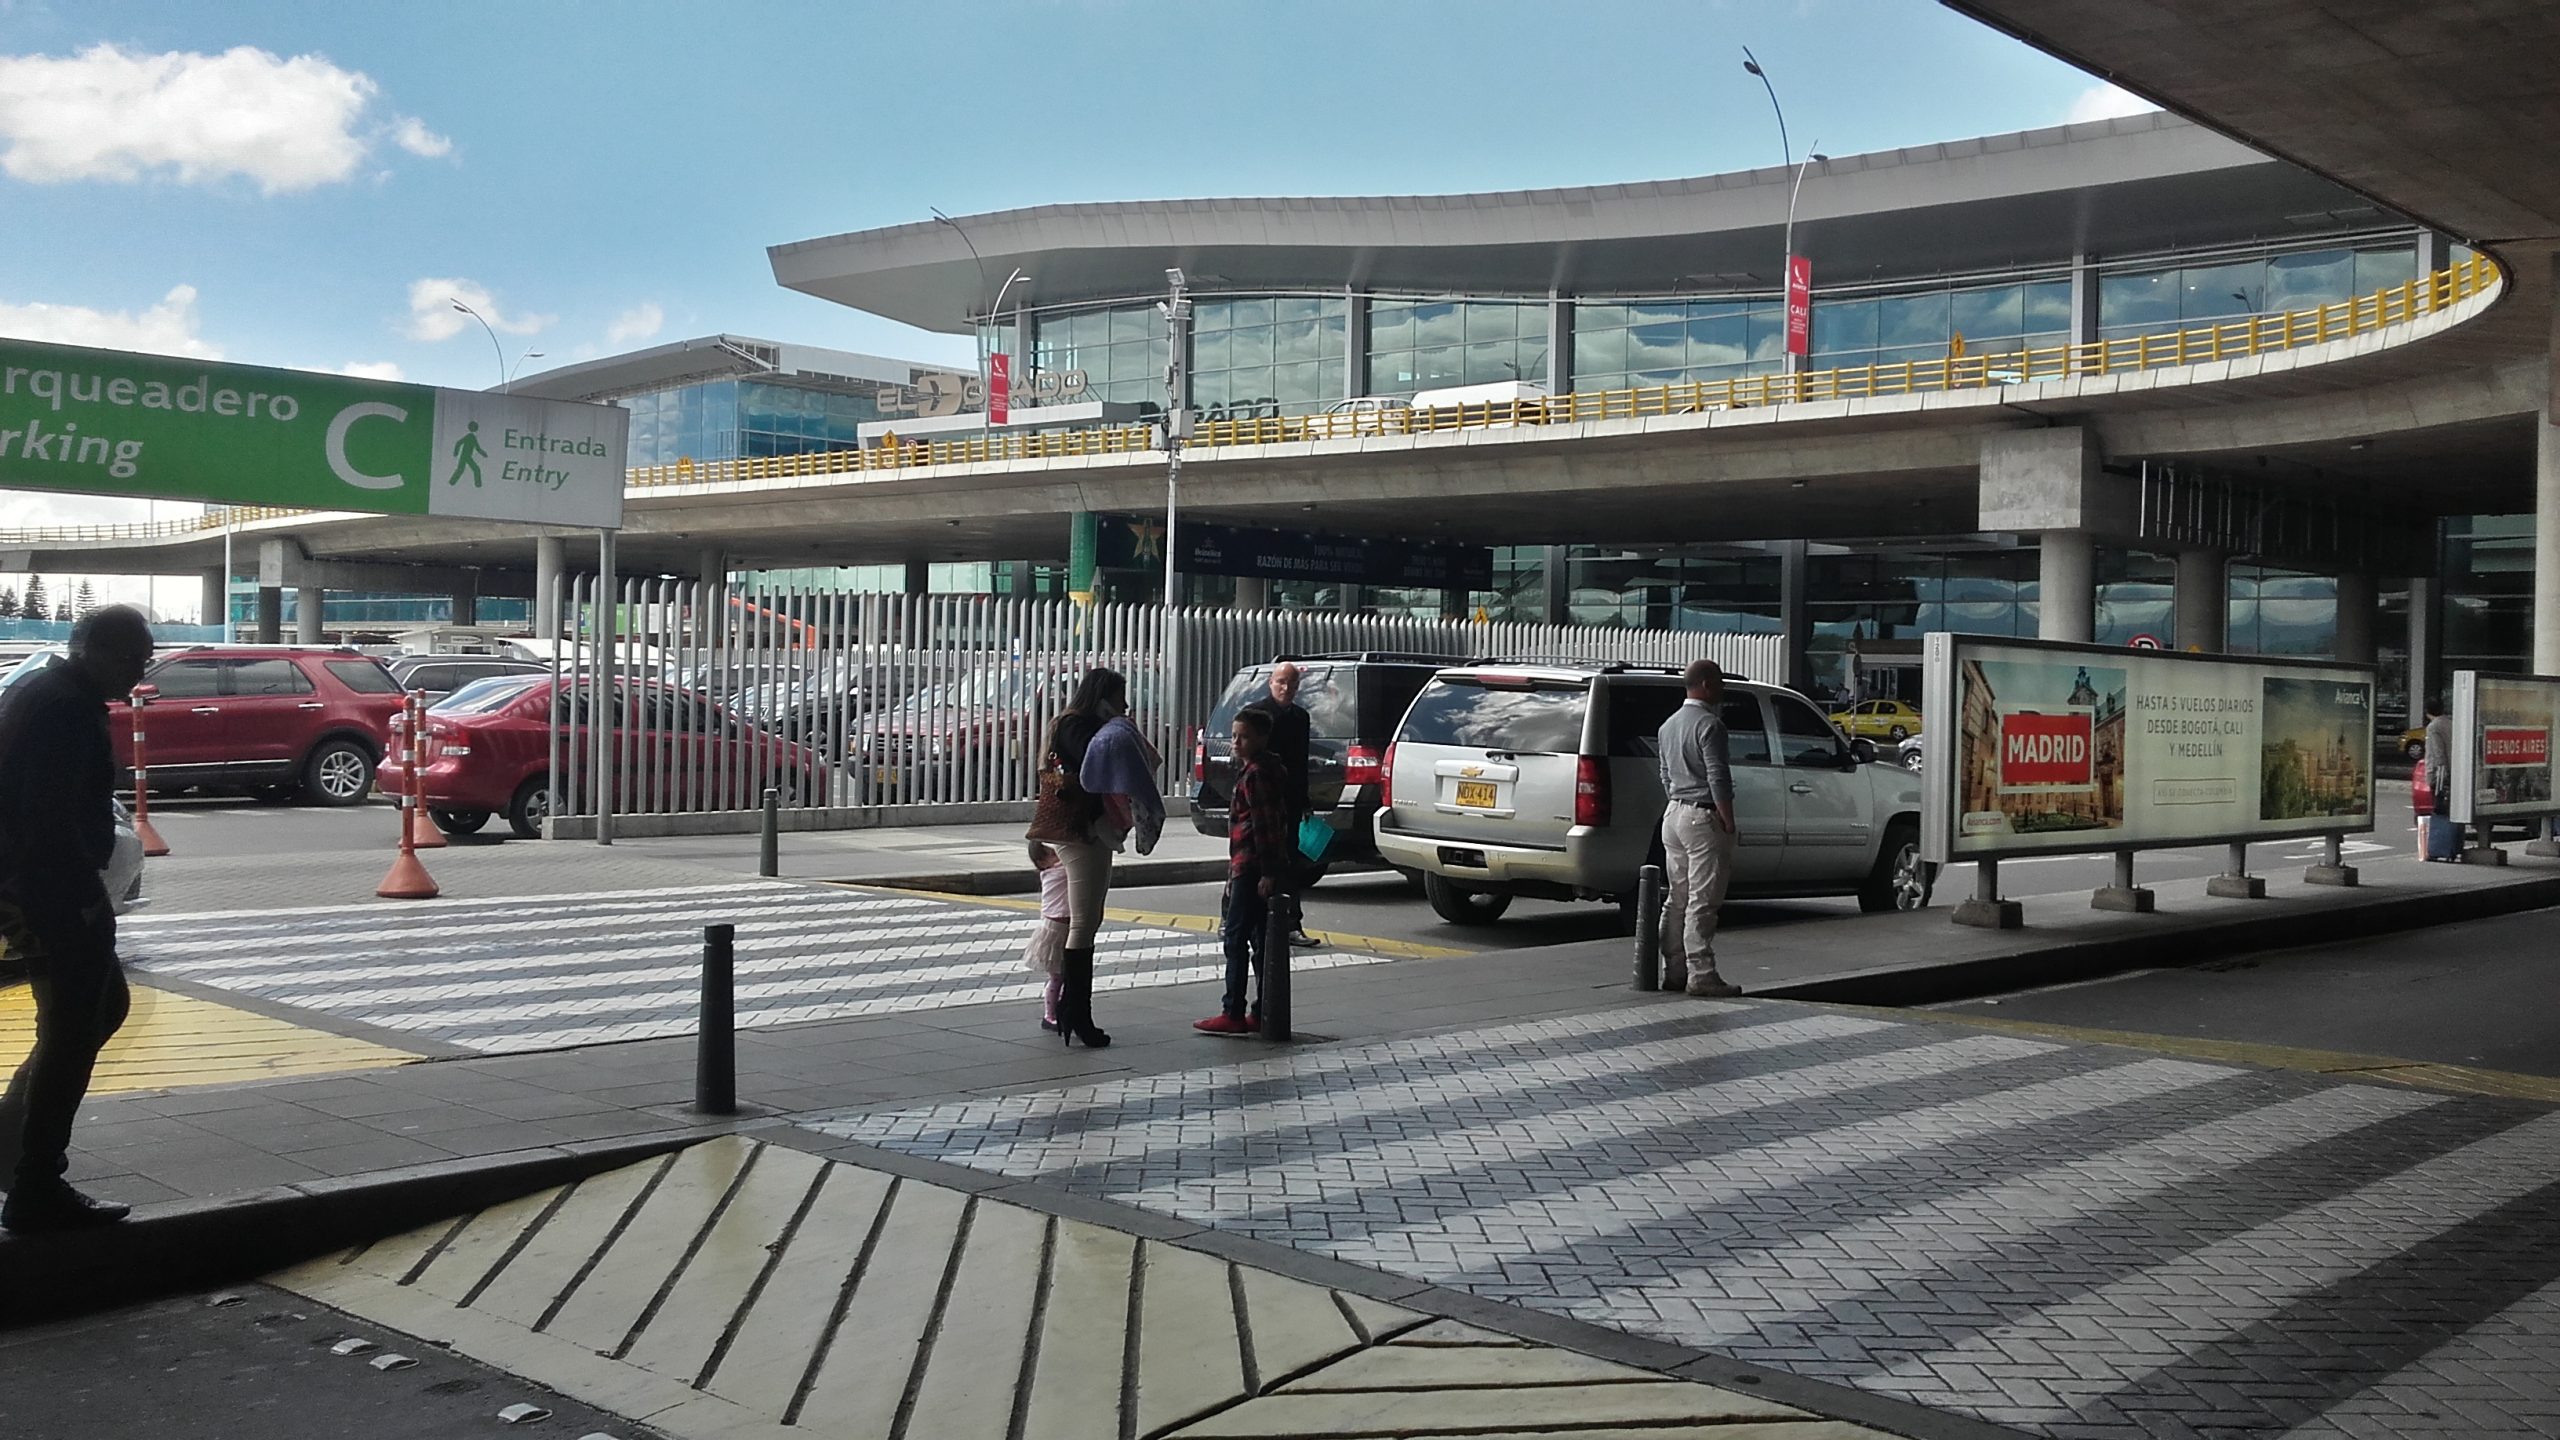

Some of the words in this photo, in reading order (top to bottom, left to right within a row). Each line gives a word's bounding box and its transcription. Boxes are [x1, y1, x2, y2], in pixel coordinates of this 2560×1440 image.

[1790, 304, 1807, 316] CALI
[5, 366, 299, 421] rqueadero
[877, 388, 917, 413] EL
[918, 368, 1087, 417] DOADO
[0, 419, 144, 478] rking
[326, 401, 408, 490] C
[504, 429, 607, 458] Entrada
[502, 461, 570, 491] Entry
[1256, 553, 1282, 568] RAZÓN
[1283, 557, 1293, 569] DE
[2136, 695, 2169, 710] HASTA
[2171, 696, 2177, 710] 5
[2180, 697, 2215, 712] VUELOS
[2218, 698, 2254, 712] DIARIOS
[2147, 719, 2178, 734] DESDE
[2224, 721, 2243, 735] CALI
[2008, 734, 2085, 763] MADRID
[2169, 743, 2175, 757] Y
[2178, 740, 2223, 757] MEDELLÍN
[2487, 739, 2520, 754] BUENOS
[2522, 739, 2545, 753] AIRES
